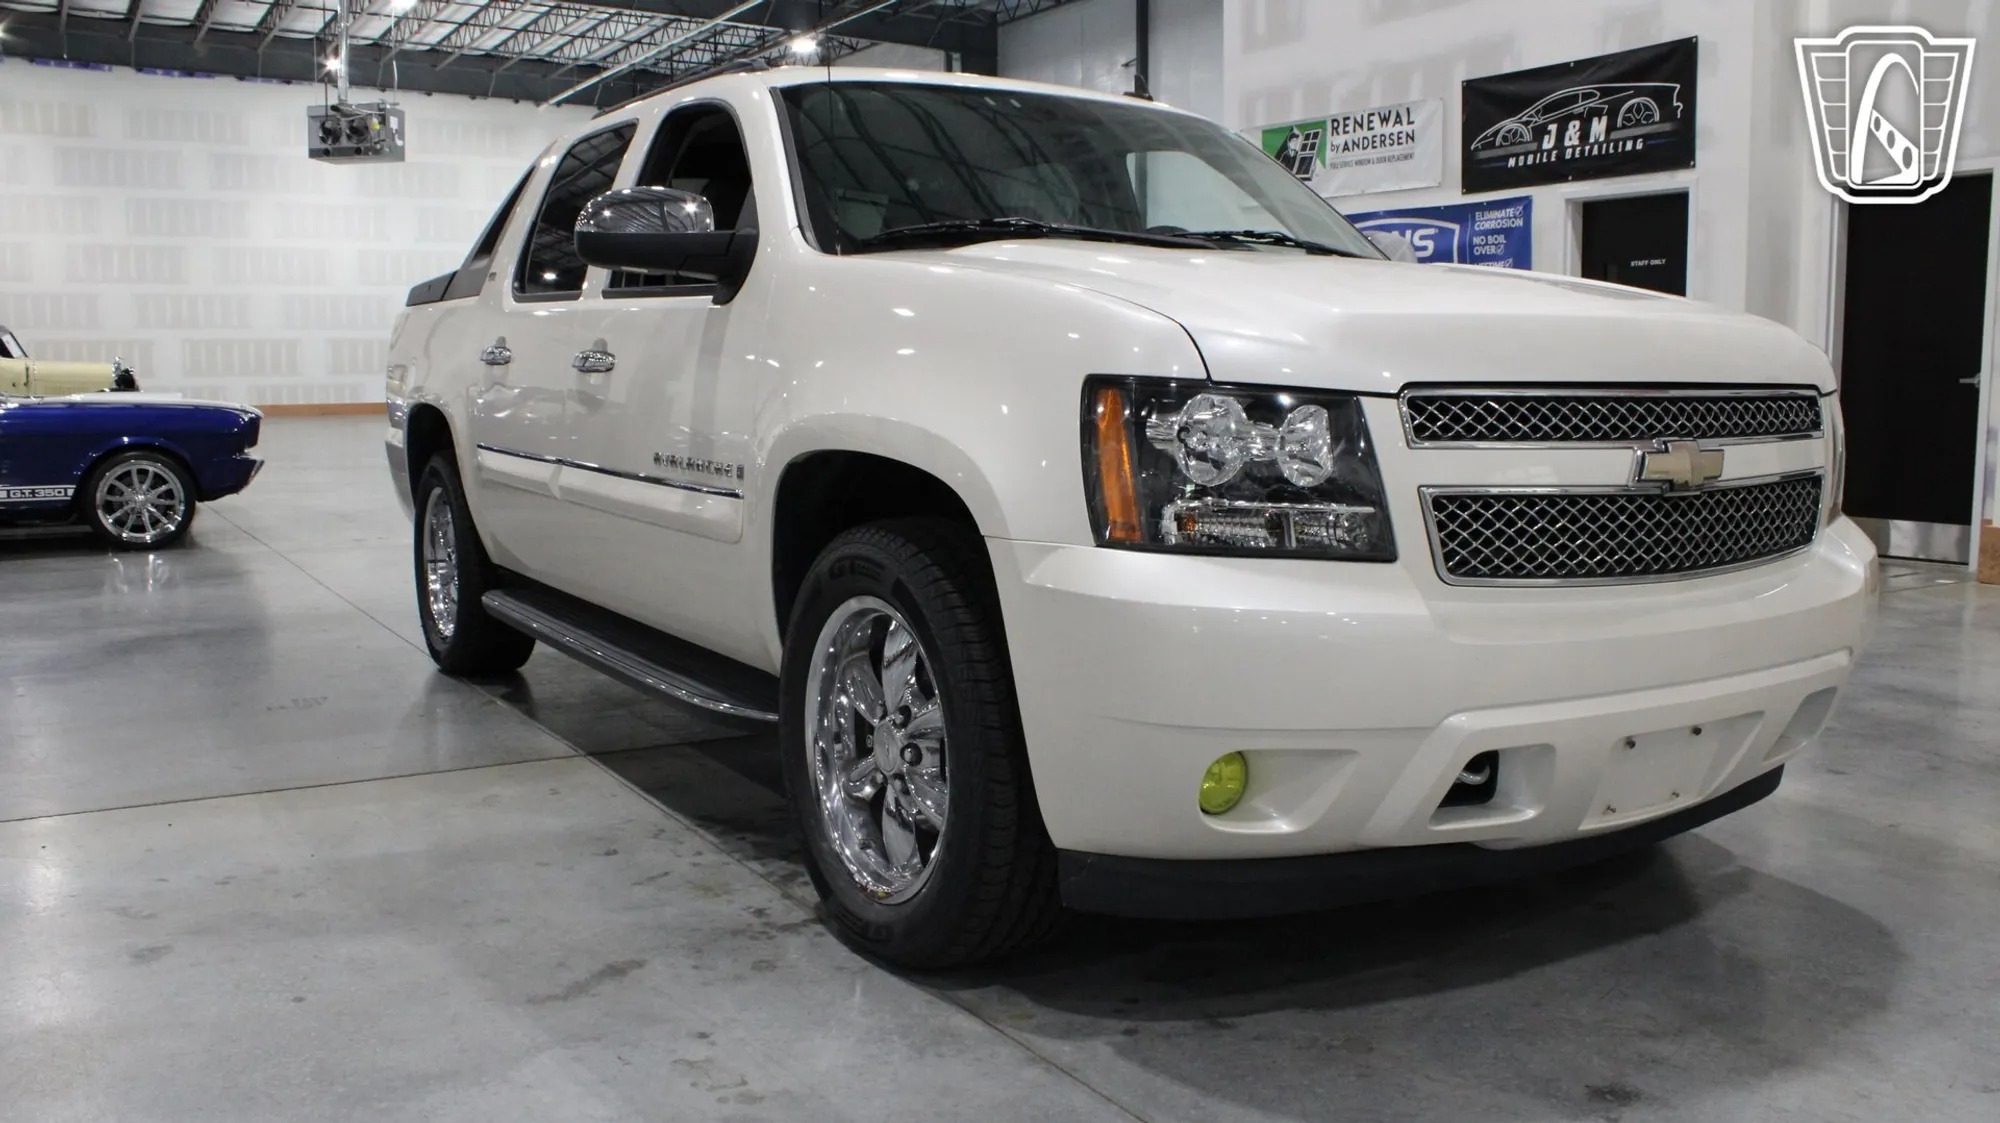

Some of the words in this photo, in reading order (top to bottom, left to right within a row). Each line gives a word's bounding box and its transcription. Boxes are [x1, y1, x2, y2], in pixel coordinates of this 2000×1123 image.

[1331, 107, 1415, 136] RENEWAL
[1330, 141, 1340, 154] by
[1342, 129, 1415, 154] ANDERSEN
[1508, 150, 1557, 168] MOBILE
[1565, 138, 1644, 160] DETAILING
[1475, 207, 1515, 221] ELIMINATE
[1474, 217, 1523, 231] CORROSION
[1473, 235, 1486, 246] NO
[1487, 234, 1506, 245] BOIL
[1473, 244, 1497, 256] OVER
[1650, 258, 1666, 266] ONLY
[653, 451, 734, 478] AVALANCHE
